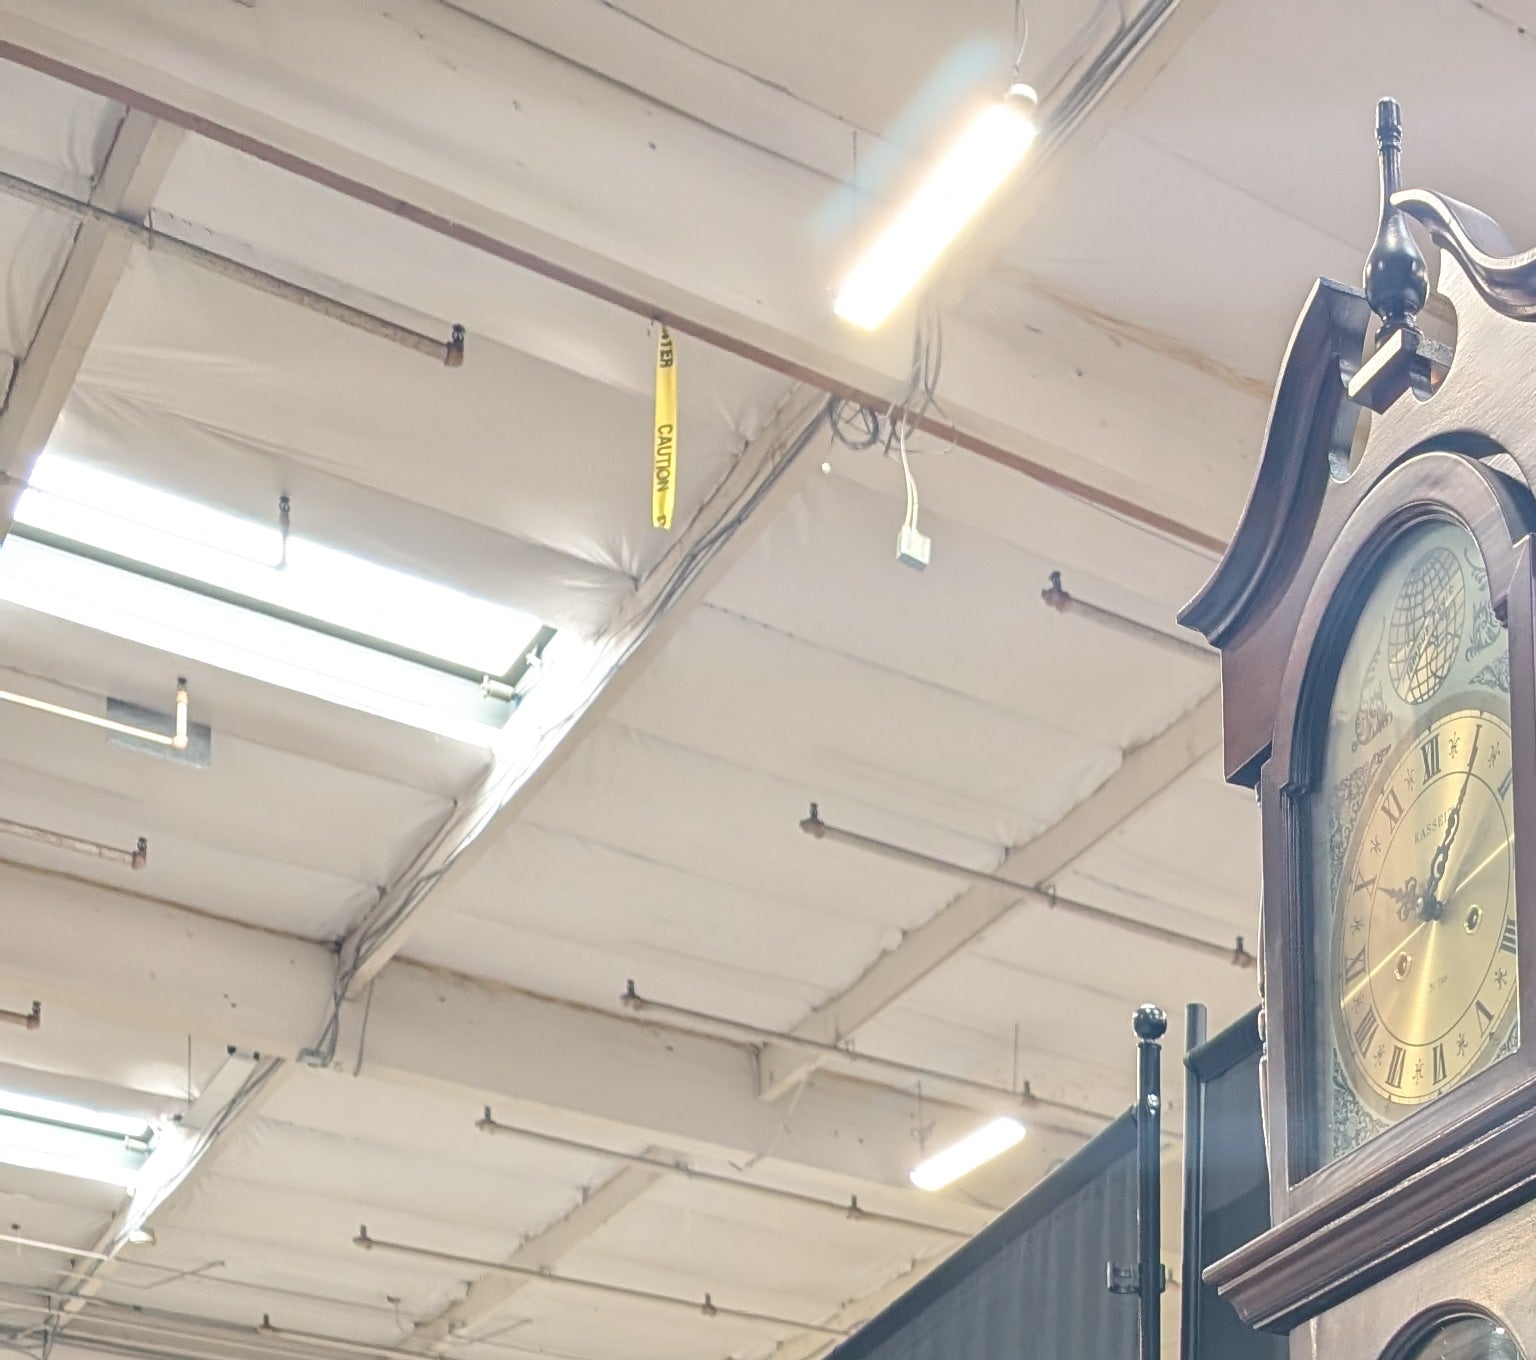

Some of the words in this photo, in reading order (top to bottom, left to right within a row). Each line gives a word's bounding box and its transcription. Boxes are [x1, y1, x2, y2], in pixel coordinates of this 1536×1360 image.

[656, 424, 673, 492] CAUTION
[1420, 733, 1441, 785] XII
[1381, 786, 1405, 834] XI
[1353, 869, 1377, 898] X
[1344, 944, 1366, 986] IX
[1354, 1004, 1379, 1059] VIII
[1475, 999, 1495, 1038] V
[1385, 1045, 1406, 1089] VII
[1431, 1042, 1447, 1086] VI
